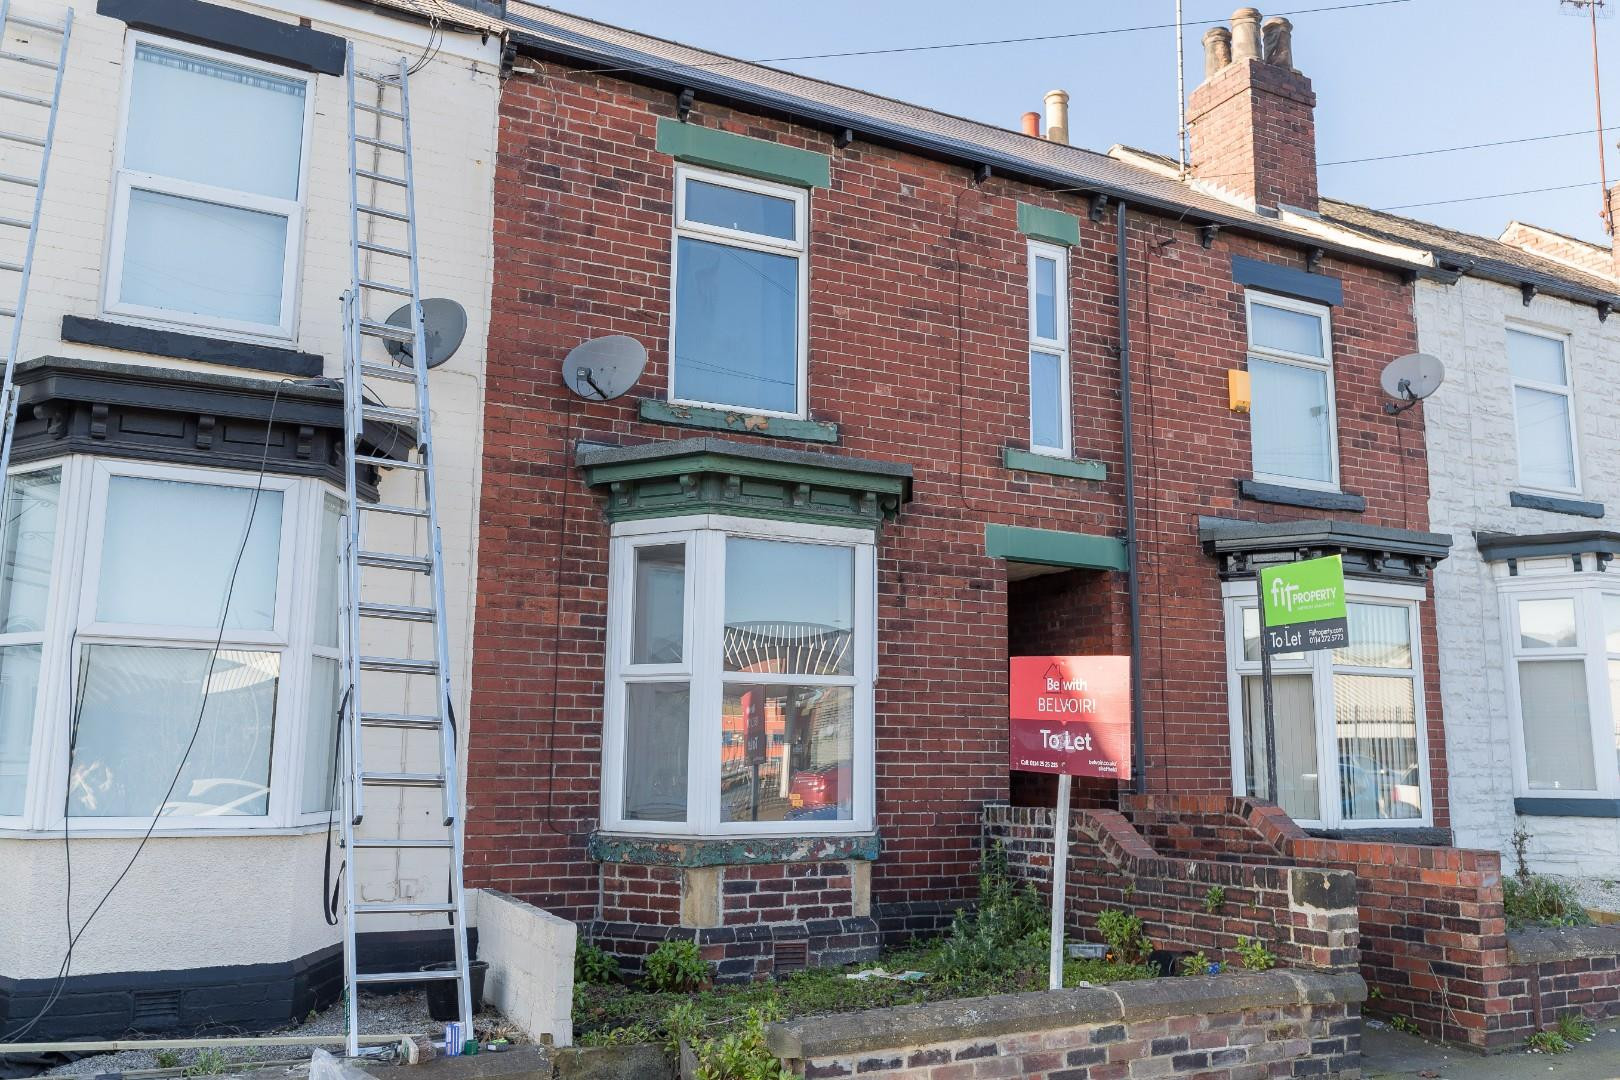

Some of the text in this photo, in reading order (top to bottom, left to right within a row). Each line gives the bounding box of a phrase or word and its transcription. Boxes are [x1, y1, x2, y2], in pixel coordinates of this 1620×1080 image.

[1293, 587, 1336, 605] PROPERTY
[1269, 630, 1302, 648] To Let
[1321, 635, 1331, 643] 272
[1331, 633, 1344, 642] 5773
[1047, 677, 1087, 691] Be with
[1038, 697, 1096, 713] BELVOIR!
[1039, 729, 1092, 751] To Let
